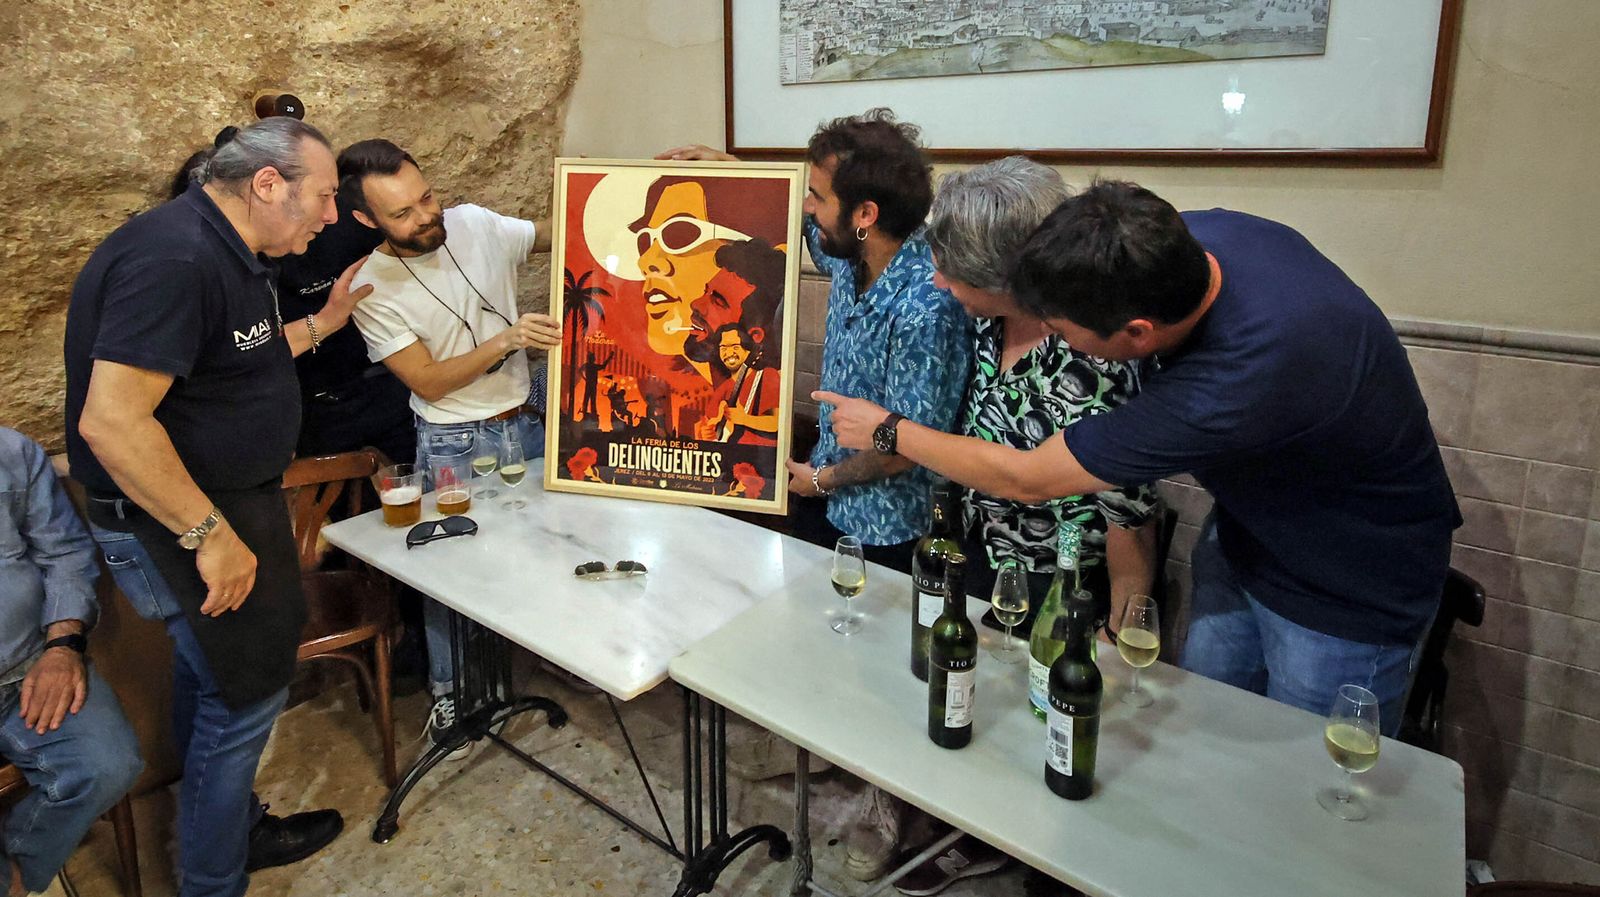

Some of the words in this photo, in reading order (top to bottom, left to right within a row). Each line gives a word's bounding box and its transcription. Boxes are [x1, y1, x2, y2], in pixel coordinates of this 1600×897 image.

[286, 105, 295, 113] 20
[631, 437, 643, 445] LA
[645, 438, 667, 447] FERIA
[670, 440, 680, 448] DE
[683, 441, 699, 450] LOS
[608, 442, 722, 477] DELINQÜENTES
[1051, 695, 1075, 713] PEPE
